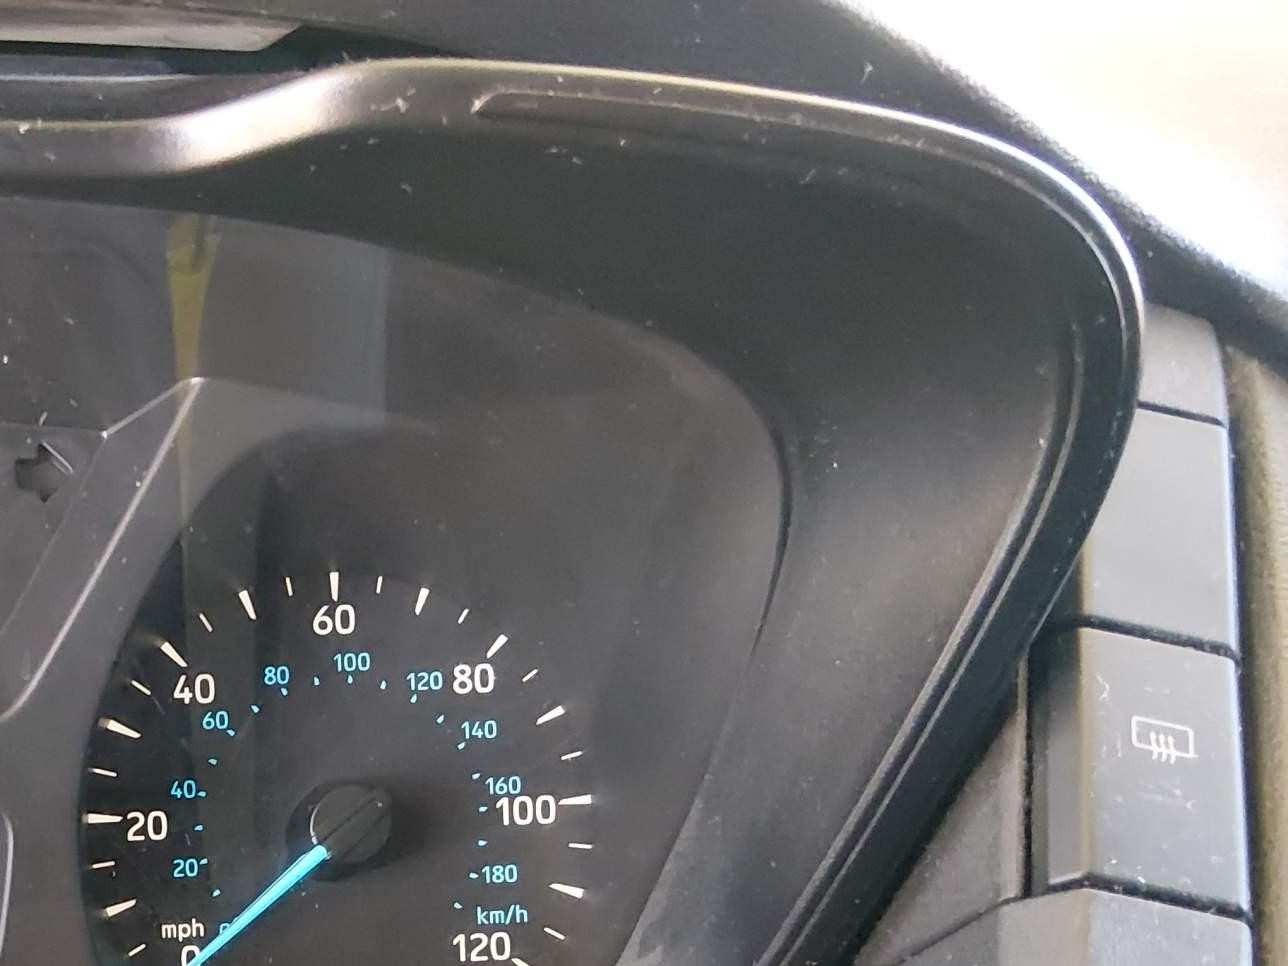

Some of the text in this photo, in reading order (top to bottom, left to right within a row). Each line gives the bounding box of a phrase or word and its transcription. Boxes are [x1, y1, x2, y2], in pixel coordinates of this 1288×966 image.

[313, 604, 355, 635] 60
[333, 652, 370, 672] 100
[263, 666, 290, 685] 80
[406, 672, 443, 691] 120
[453, 663, 495, 694] 80
[173, 673, 215, 704] 40
[202, 711, 228, 730] 60
[461, 720, 497, 739] 140
[170, 780, 196, 799] 40
[485, 776, 521, 795] 160
[495, 795, 556, 825] 100
[126, 811, 168, 841] 20
[172, 859, 198, 878] 20
[481, 865, 518, 883] 180
[476, 905, 528, 926] km/h
[161, 919, 204, 943] mph
[452, 931, 511, 962] 120
